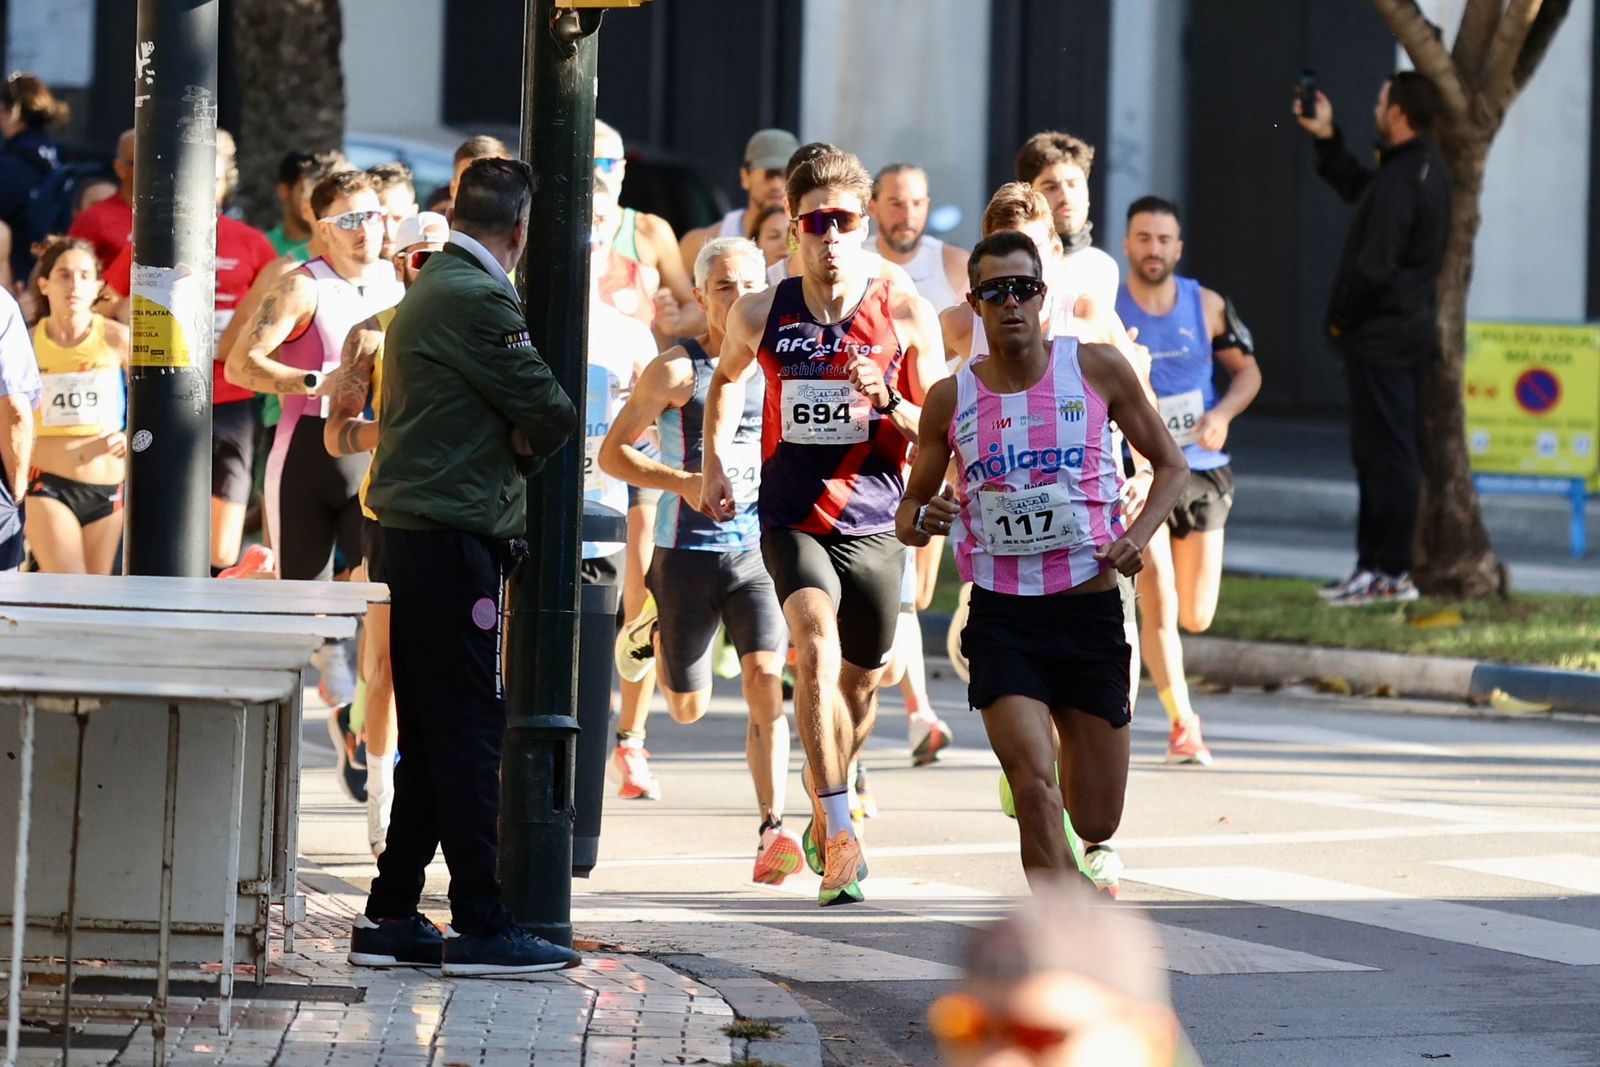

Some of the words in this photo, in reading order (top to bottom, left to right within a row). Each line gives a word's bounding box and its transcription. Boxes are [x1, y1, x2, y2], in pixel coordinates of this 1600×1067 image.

[775, 337, 816, 353] RFC
[51, 391, 98, 409] 409
[793, 403, 851, 424] 694
[995, 509, 1054, 536] 117
